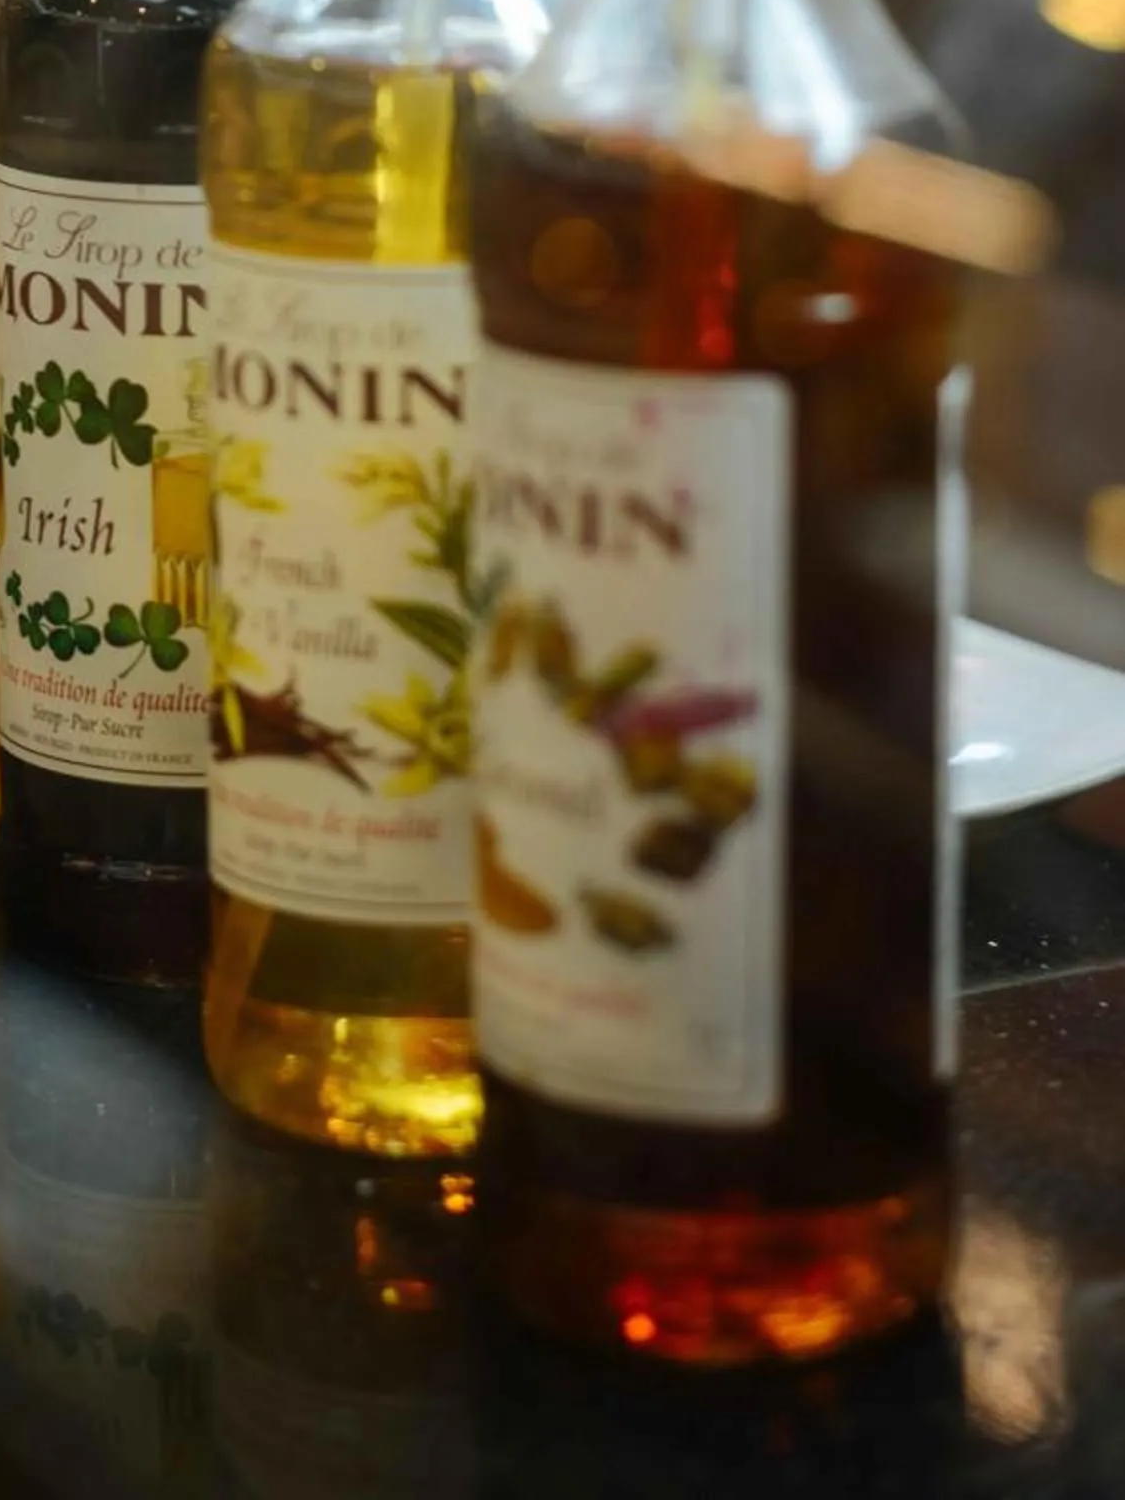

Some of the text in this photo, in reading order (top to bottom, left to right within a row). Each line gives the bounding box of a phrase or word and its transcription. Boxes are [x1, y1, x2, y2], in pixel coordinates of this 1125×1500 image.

[2, 205, 203, 280] Le Sirop de
[18, 496, 117, 556] Irish
[22, 666, 97, 706] tradition
[103, 679, 129, 709] de
